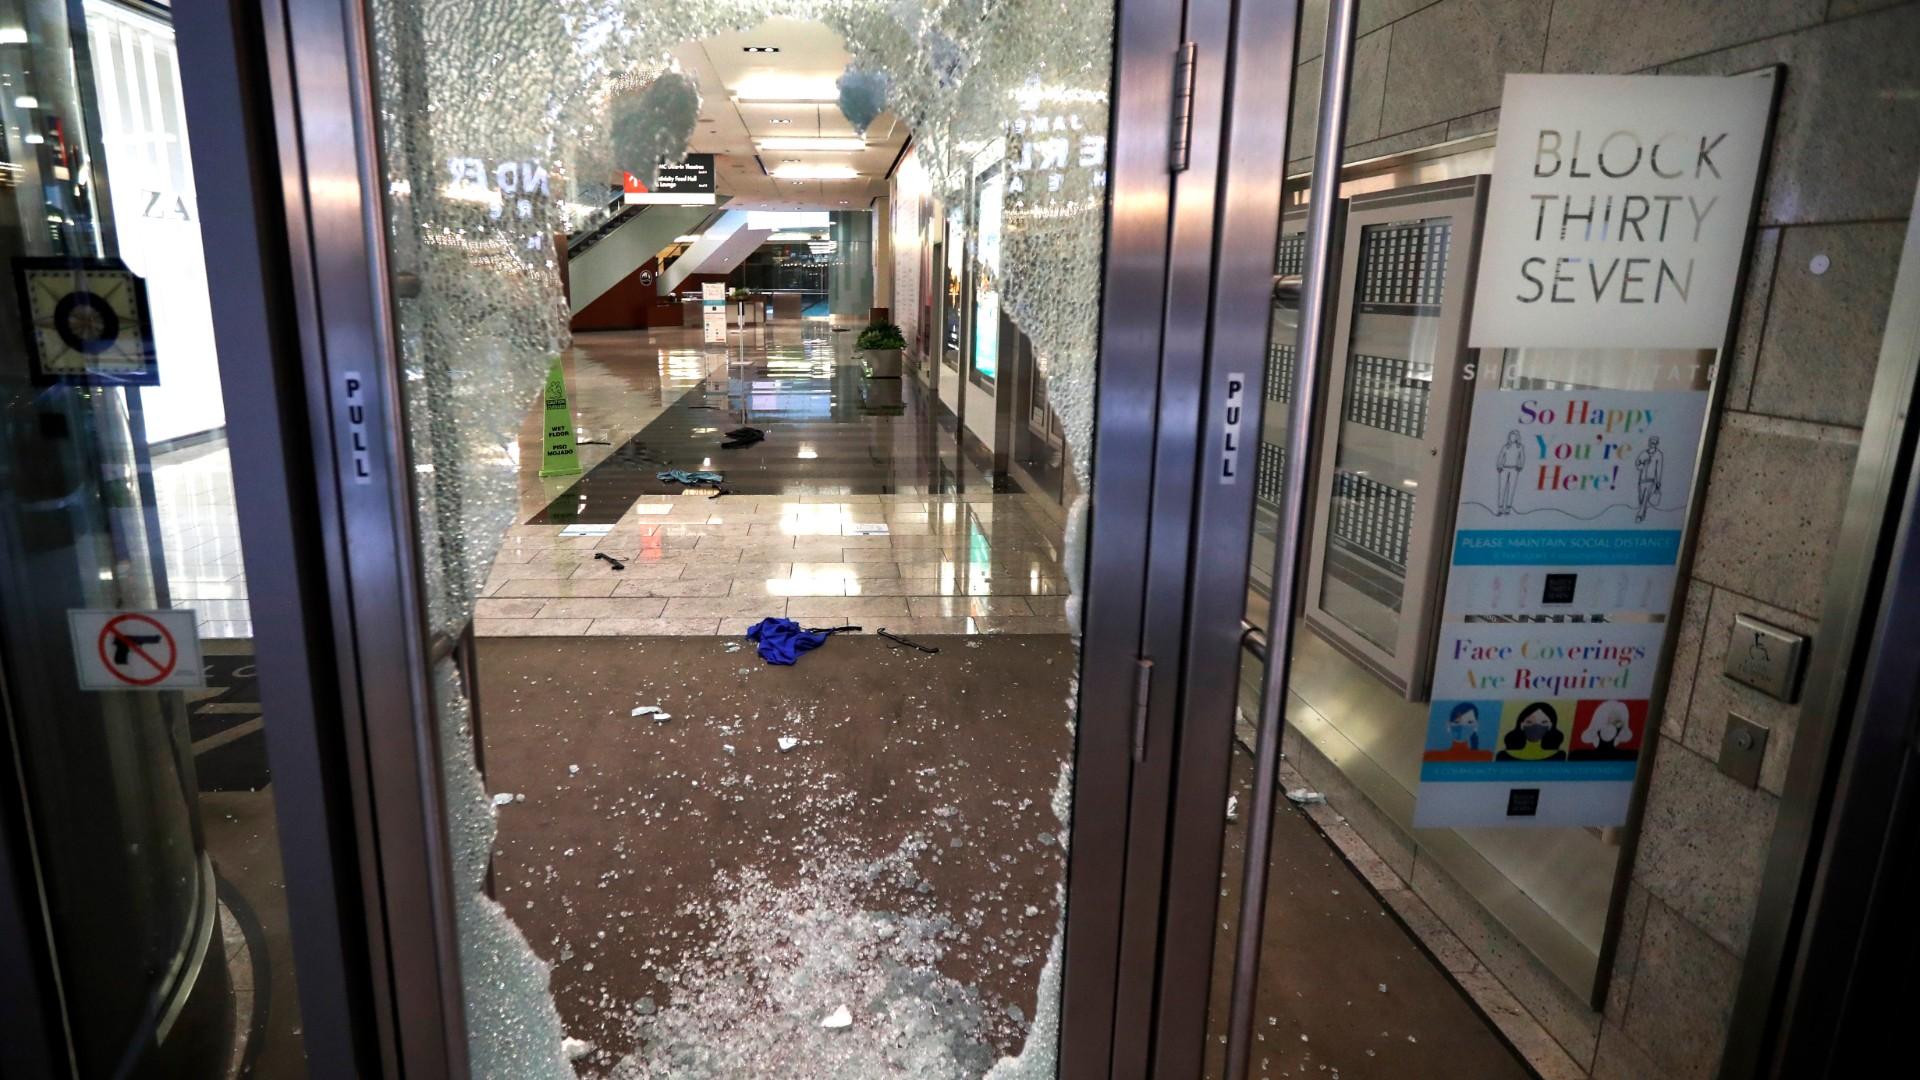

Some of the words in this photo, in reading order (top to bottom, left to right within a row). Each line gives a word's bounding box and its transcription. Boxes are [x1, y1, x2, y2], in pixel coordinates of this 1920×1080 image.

[1534, 130, 1728, 179] BLOCK
[1531, 195, 1718, 242] THIRTY
[1516, 257, 1695, 303] SEVEN
[346, 379, 368, 477] PULL
[1223, 381, 1242, 477] PULL
[1518, 400, 1555, 425] So
[1566, 400, 1657, 433] Happy
[1536, 434, 1632, 460] You're
[1537, 465, 1619, 490] Here!
[1462, 537, 1503, 549] PLEASE
[1507, 537, 1566, 549] MAINTAIN
[1570, 537, 1610, 549] SOCIAL
[1454, 639, 1512, 660] Face
[1521, 639, 1645, 667] Coverings
[1465, 668, 1505, 689] Are
[1514, 668, 1630, 696] Required
